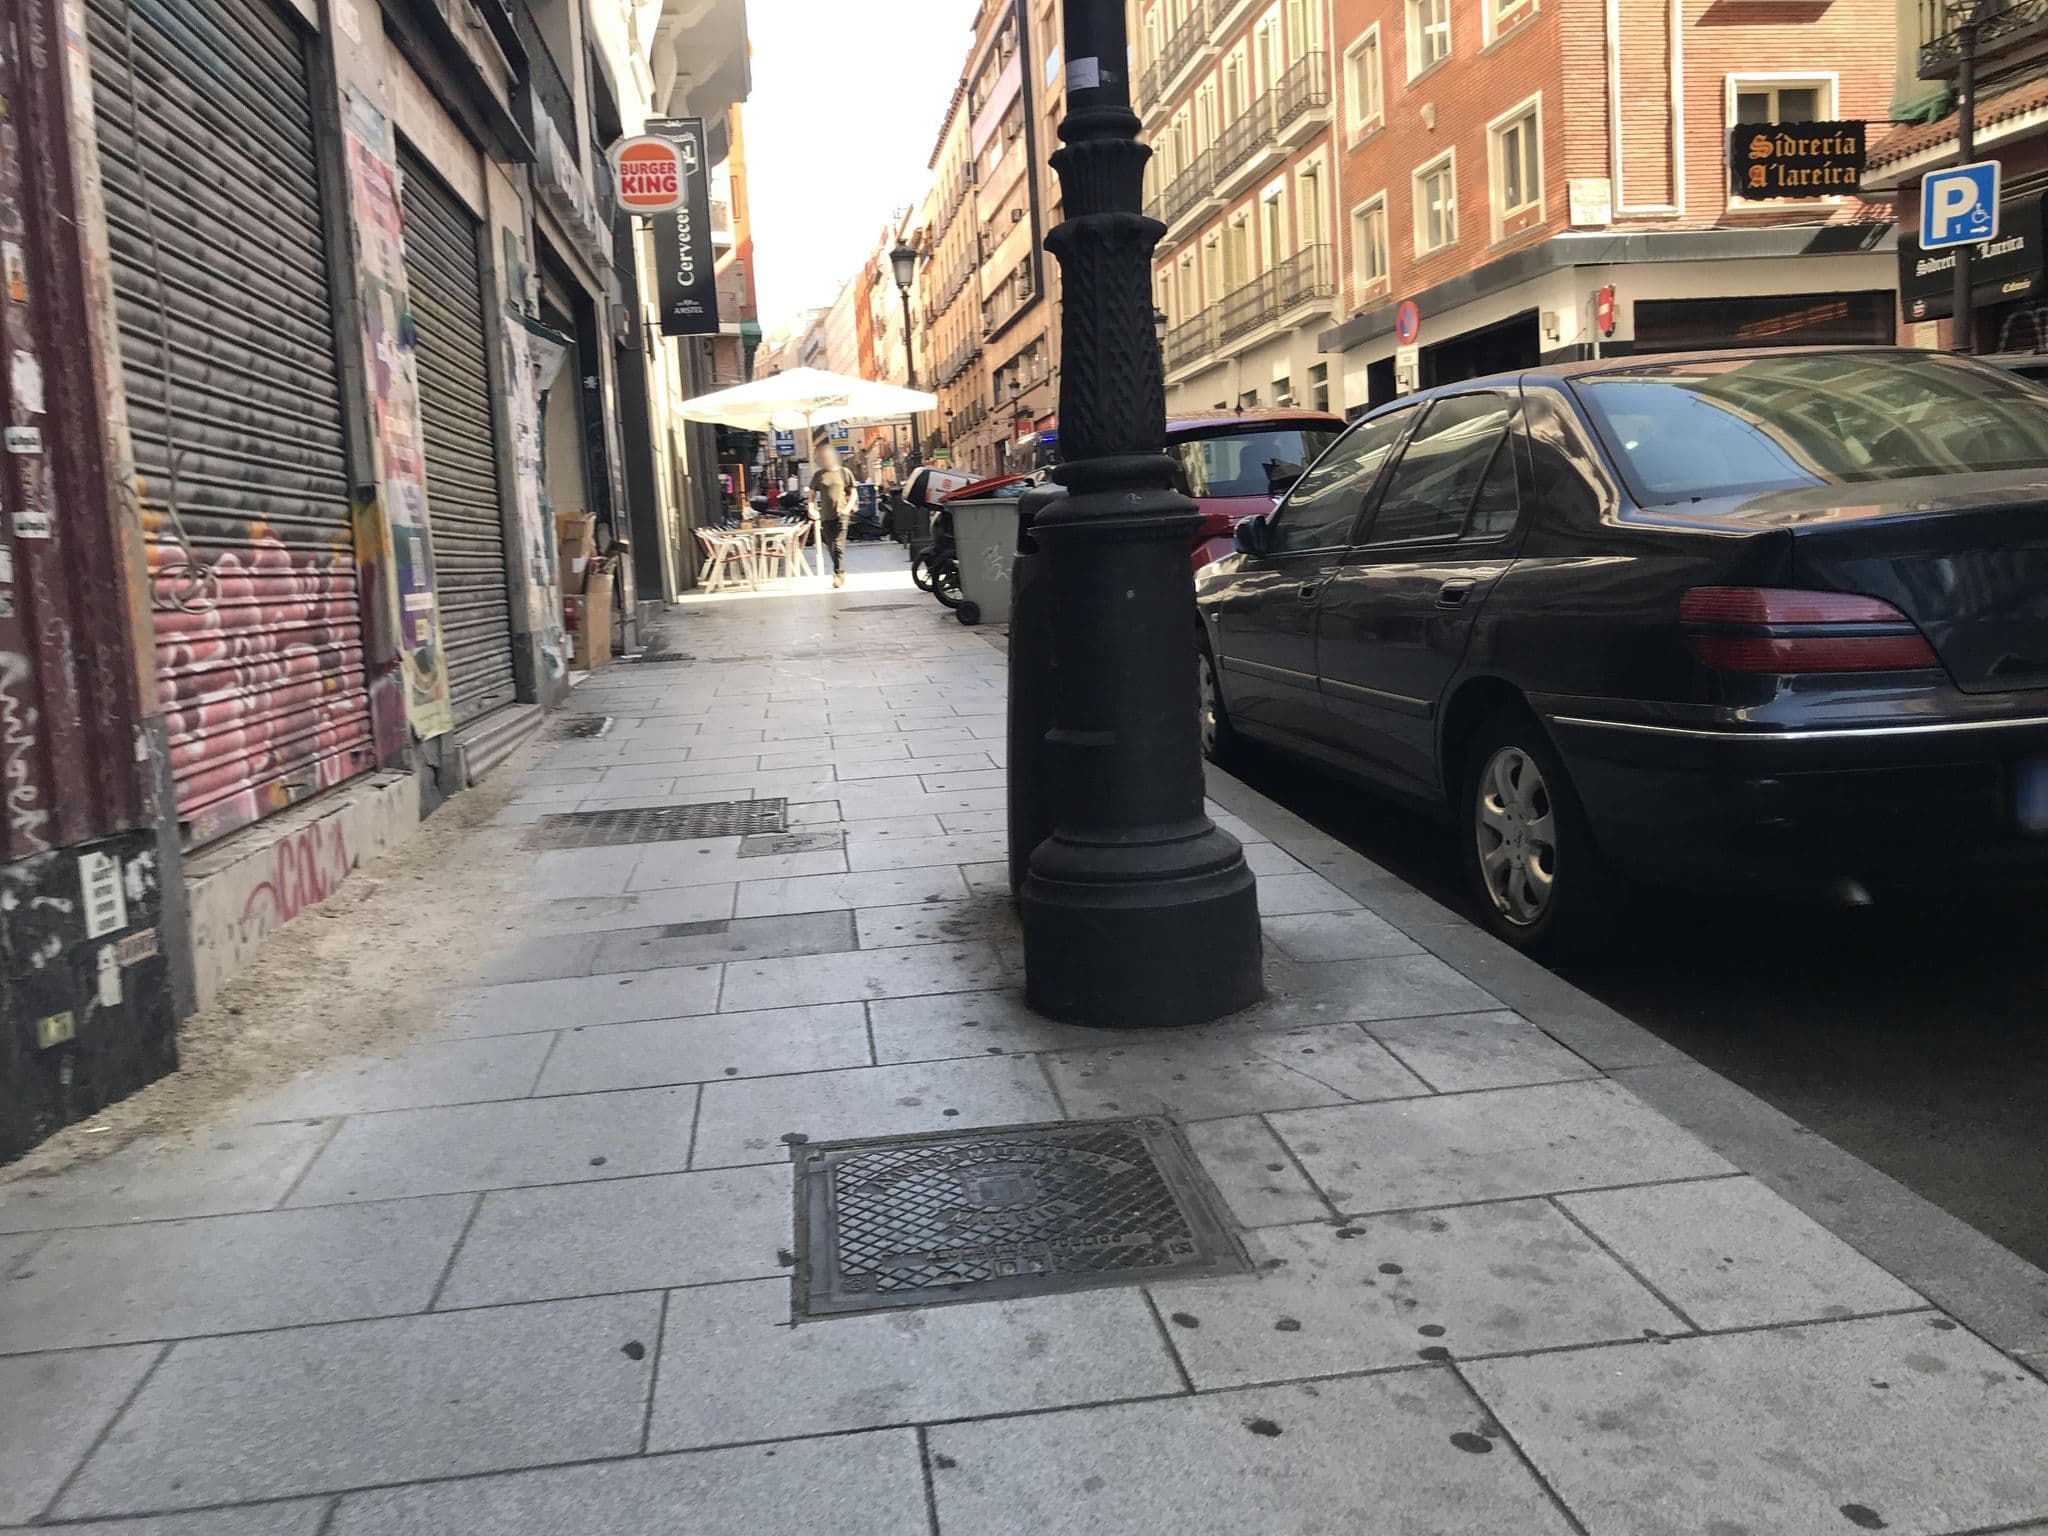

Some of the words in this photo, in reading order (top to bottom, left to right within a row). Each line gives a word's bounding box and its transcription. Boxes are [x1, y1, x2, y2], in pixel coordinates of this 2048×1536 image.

[1748, 131, 1856, 159] Sidrería
[620, 162, 677, 176] BURGER
[621, 175, 678, 194] KING
[1932, 176, 1979, 240] P
[675, 207, 696, 287] Cervecer
[673, 305, 704, 315] AMSTEL
